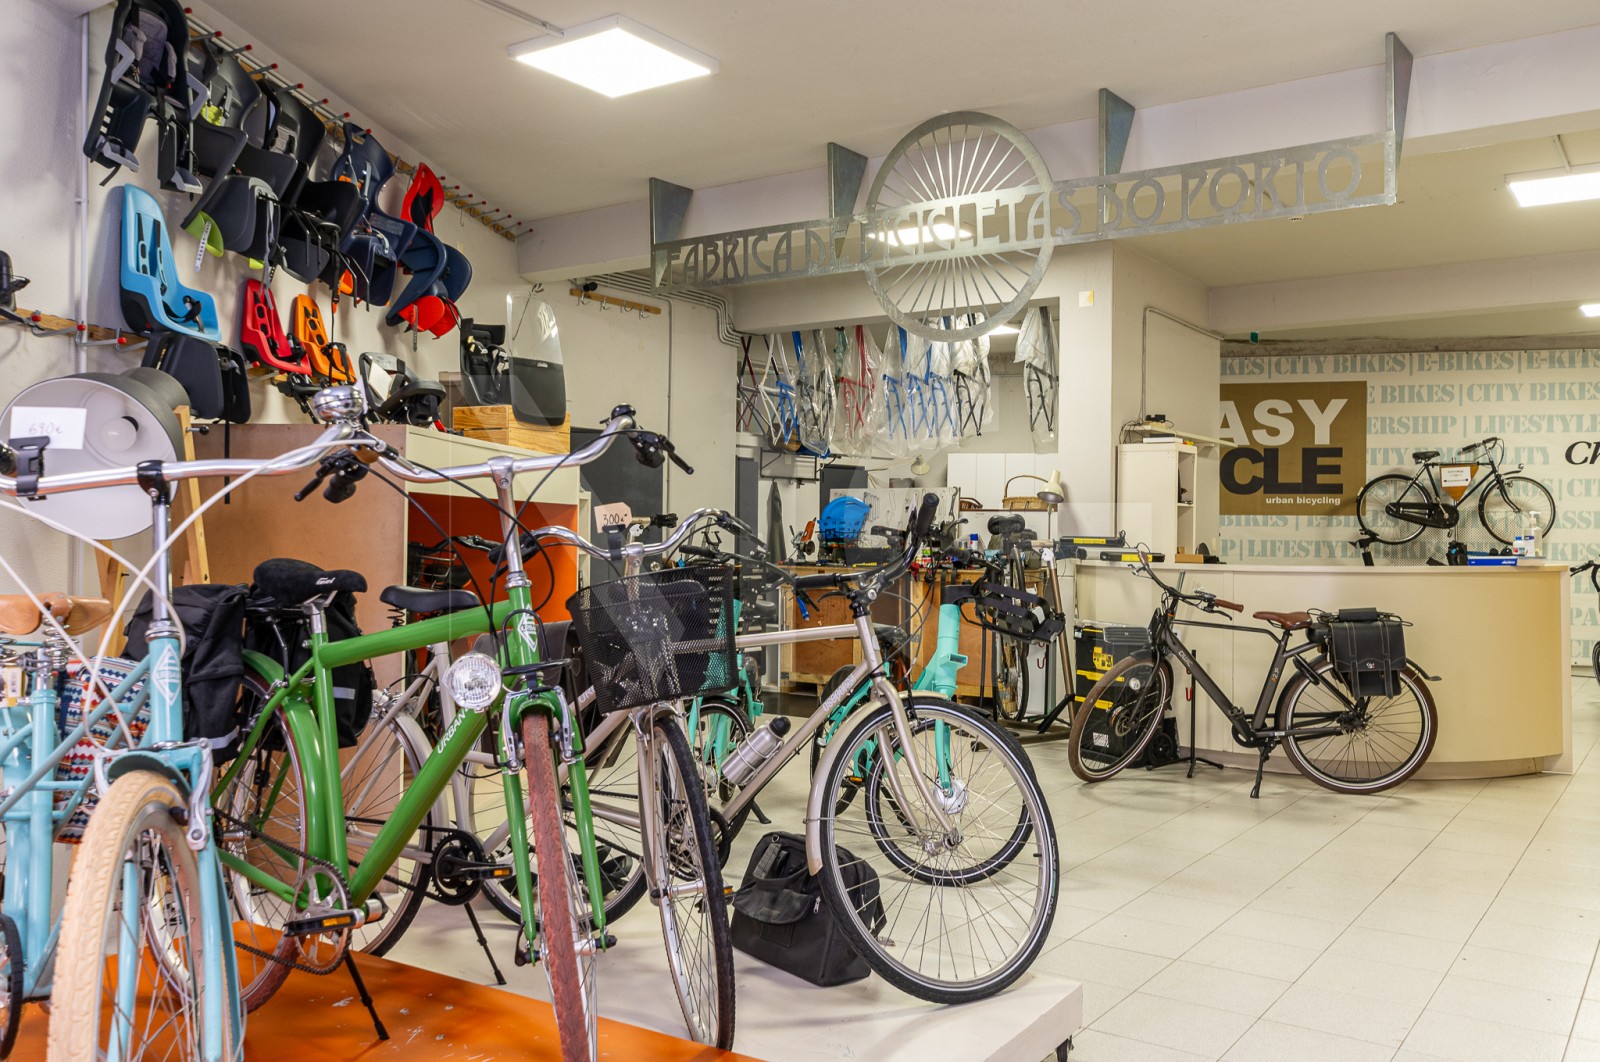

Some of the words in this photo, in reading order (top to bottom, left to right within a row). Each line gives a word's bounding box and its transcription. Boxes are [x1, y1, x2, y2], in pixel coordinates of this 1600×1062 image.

[666, 230, 793, 286] FABRICA
[860, 184, 1081, 266] BICICLETAS
[1097, 177, 1165, 236] DO
[1180, 149, 1362, 221] PORTO
[1274, 356, 1328, 375] CITY
[1332, 354, 1407, 374] BIKES
[1381, 384, 1456, 404] BIKES
[1466, 382, 1522, 402] CITY
[1367, 446, 1409, 466] ITY
[1266, 496, 1294, 504] urban
[1296, 496, 1341, 506] bicycling
[437, 708, 466, 753] URBAN
